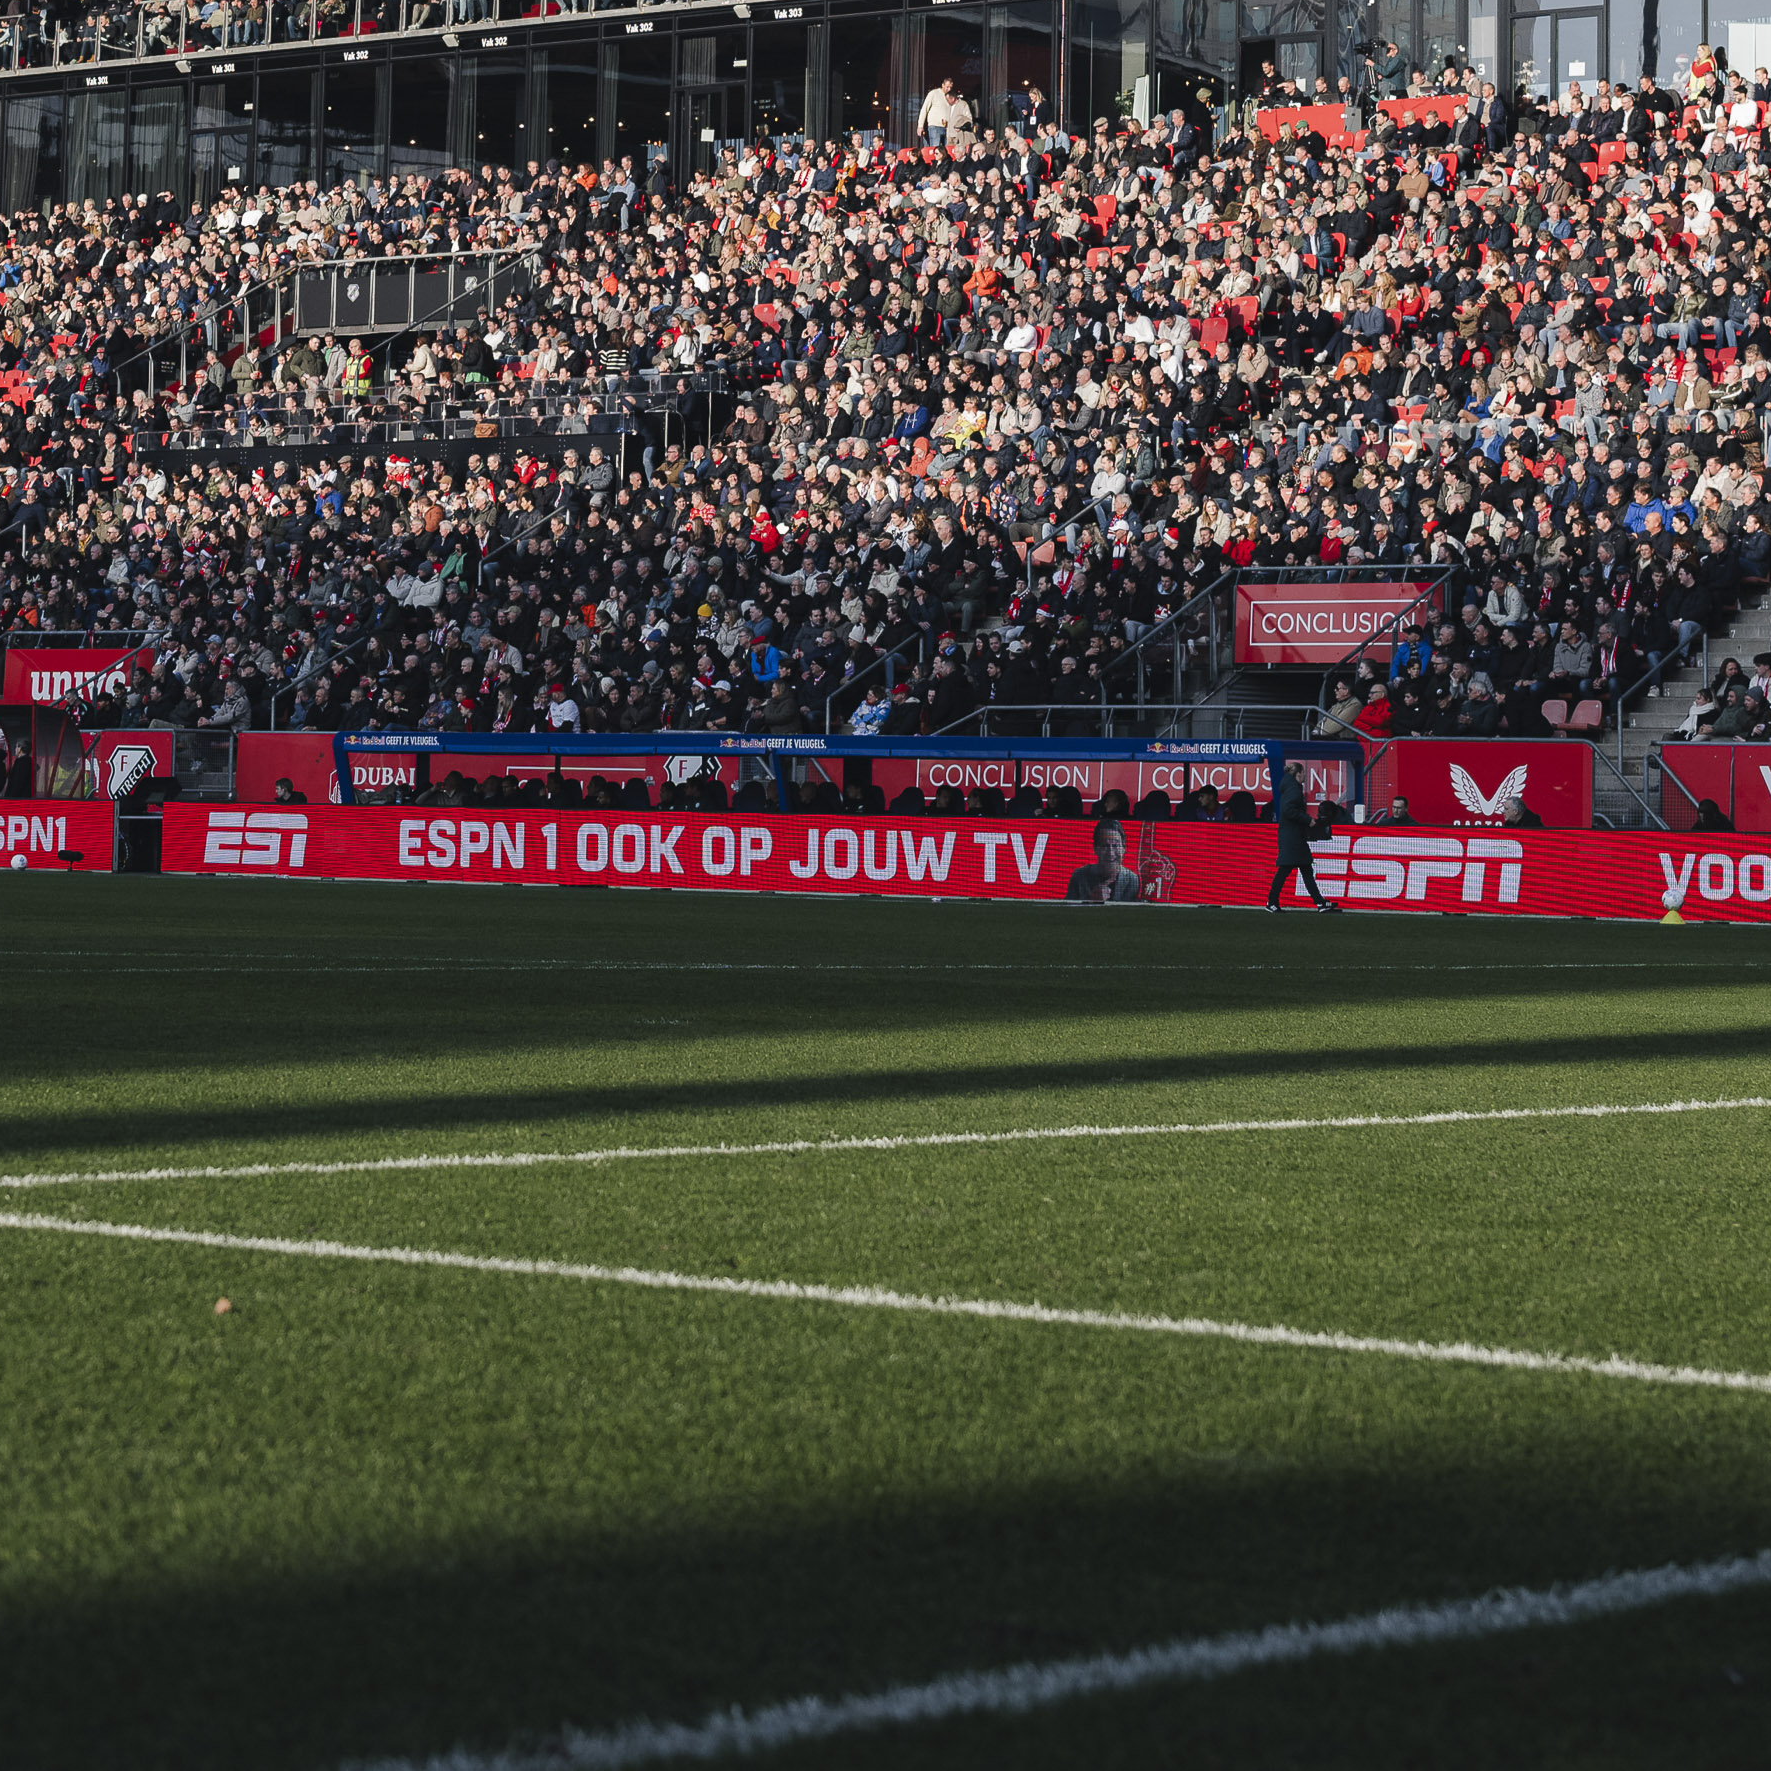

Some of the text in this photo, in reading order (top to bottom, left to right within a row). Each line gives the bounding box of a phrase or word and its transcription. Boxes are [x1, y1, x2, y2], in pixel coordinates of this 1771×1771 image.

[774, 8, 802, 19] Vak 303
[626, 22, 653, 33] Vak 302
[1261, 612, 1416, 634] CONCLUSION
[385, 737, 401, 745] GEEFT
[767, 738, 784, 749] GEEFT
[1200, 742, 1219, 754] GEEFT
[121, 755, 128, 772] F
[353, 766, 416, 786] DUBAI
[930, 763, 1090, 789] CONCLUSION
[1152, 764, 1327, 792] CONCLUSN
[399, 819, 1049, 885] ESPN 1 OOK OP JOUW TV
[1295, 836, 1523, 903] ESPN
